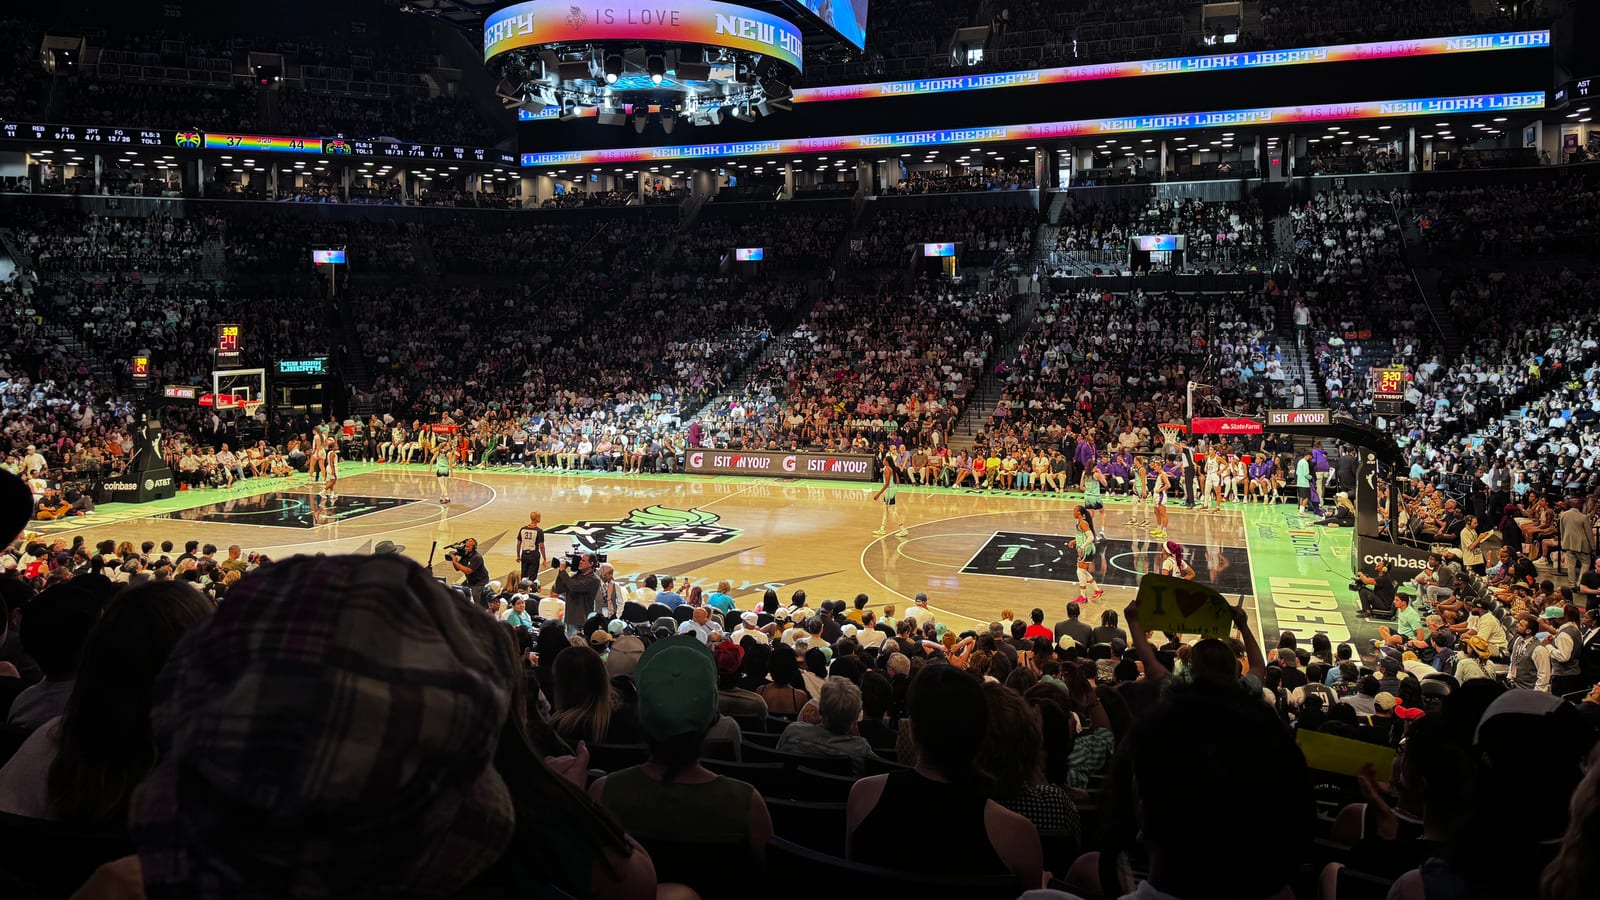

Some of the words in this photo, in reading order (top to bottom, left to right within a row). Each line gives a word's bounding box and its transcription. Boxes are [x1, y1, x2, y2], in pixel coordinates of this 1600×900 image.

[596, 8, 614, 25] IS
[628, 9, 681, 28] LOVE
[485, 12, 535, 48] ERTY
[715, 13, 775, 45] NEW
[1371, 45, 1383, 55] IS
[1390, 43, 1420, 53] LOVE
[1445, 37, 1493, 50] NEW
[1141, 60, 1182, 72] NEW
[1187, 55, 1238, 68] YORK
[1244, 49, 1328, 65] LIBERTY
[1076, 69, 1086, 78] IS
[1092, 66, 1120, 76] LOVE
[881, 82, 915, 94] NEW
[920, 78, 963, 91] YORK
[968, 72, 1039, 87] LIBERTY
[1576, 80, 1590, 88] AST
[841, 87, 864, 96] LOVE
[1311, 108, 1323, 117] IS
[1329, 106, 1360, 116] LOVE
[1379, 102, 1423, 114] NEW
[1428, 97, 1482, 110] YORK
[1100, 119, 1137, 130] NEW
[1142, 115, 1190, 128] YORK
[1195, 109, 1273, 125] LIBERTY
[1040, 126, 1050, 134] IS
[1055, 123, 1082, 133] LOVE
[226, 135, 243, 147] 37
[289, 138, 305, 150] 44
[822, 138, 846, 148] LOVE
[860, 135, 892, 147] NEW
[895, 133, 937, 144] YORK
[940, 128, 1007, 142] LIBERTY
[617, 150, 640, 159] LOVE
[652, 148, 680, 158] NEW
[684, 145, 720, 155] YORK
[723, 142, 781, 154] LIBERTY
[530, 152, 582, 164] LIBERTY
[220, 335, 236, 350] 24
[1381, 380, 1397, 391] 24
[1273, 414, 1281, 423] IS
[1281, 414, 1289, 423] IT
[1301, 414, 1325, 423] YOU?
[690, 452, 704, 468] G
[713, 455, 722, 467] IS
[722, 455, 732, 467] IT
[747, 457, 771, 469] YOU?
[782, 455, 796, 472] G
[807, 459, 816, 471] IS
[817, 460, 826, 471] IT
[842, 461, 868, 473] YOU?
[103, 481, 137, 491] coinbase
[154, 477, 172, 487] AT&T
